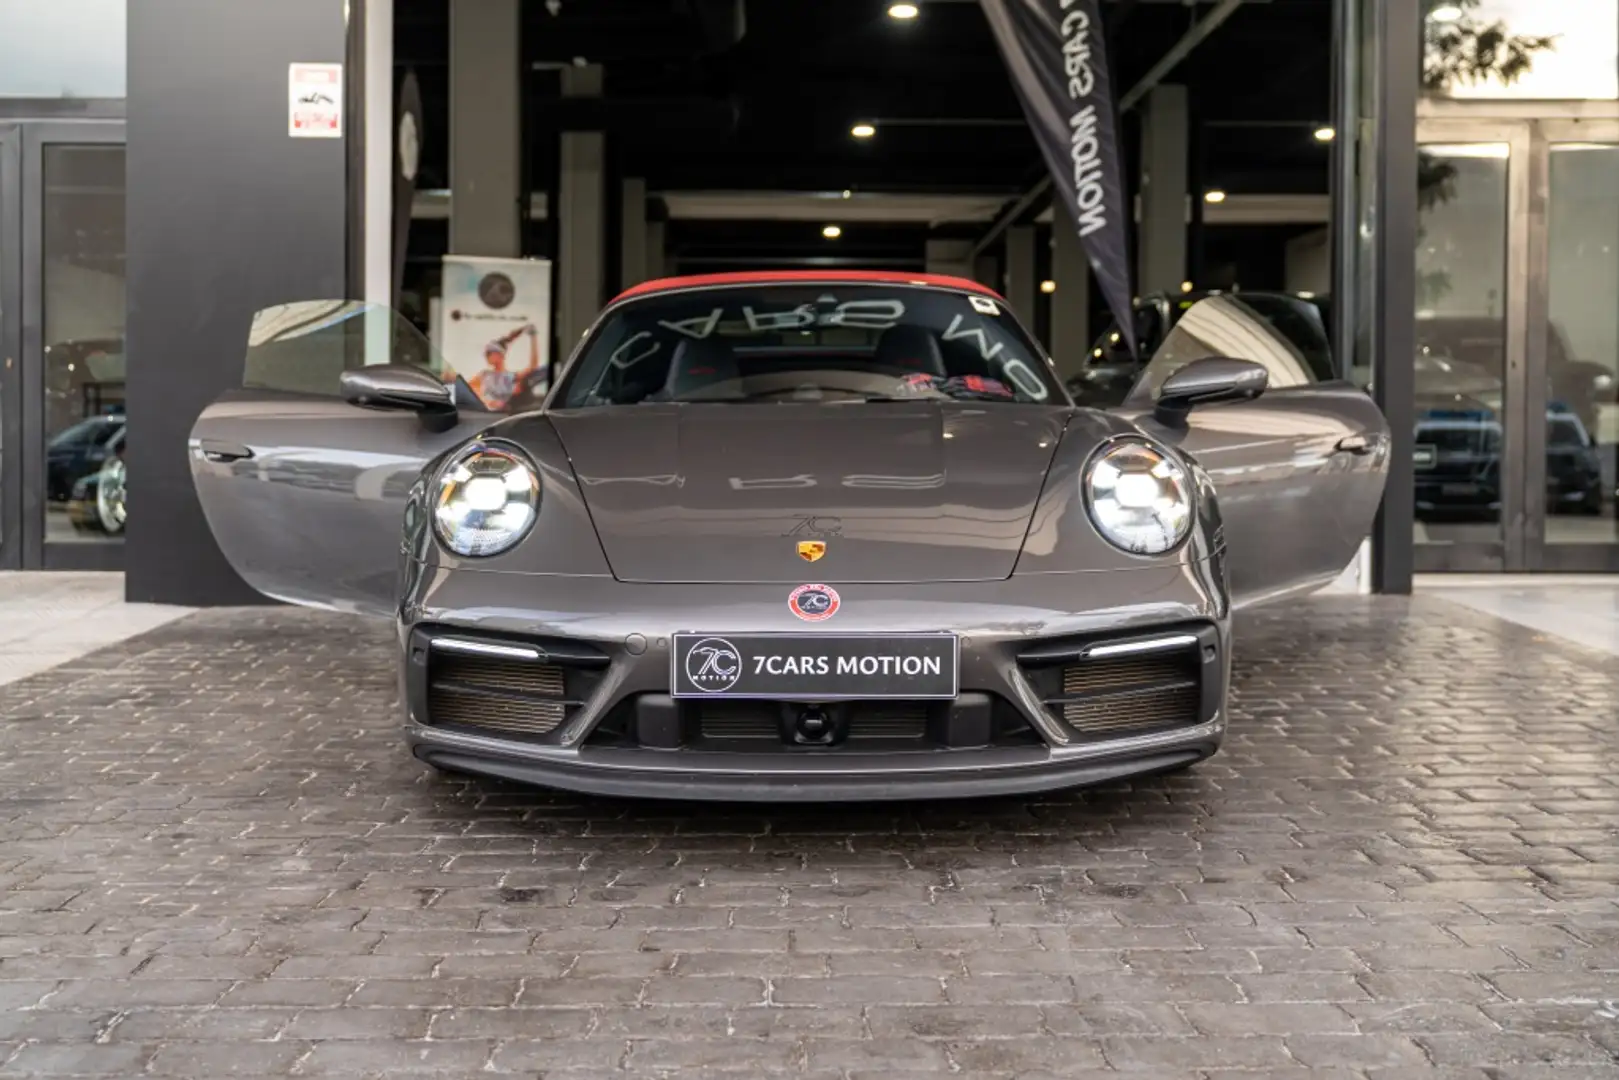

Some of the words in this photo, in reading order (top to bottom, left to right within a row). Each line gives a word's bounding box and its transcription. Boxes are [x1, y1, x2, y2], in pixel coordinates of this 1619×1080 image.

[692, 646, 737, 675] 7C
[753, 655, 829, 675] 7CARS
[836, 656, 941, 675] MOTION
